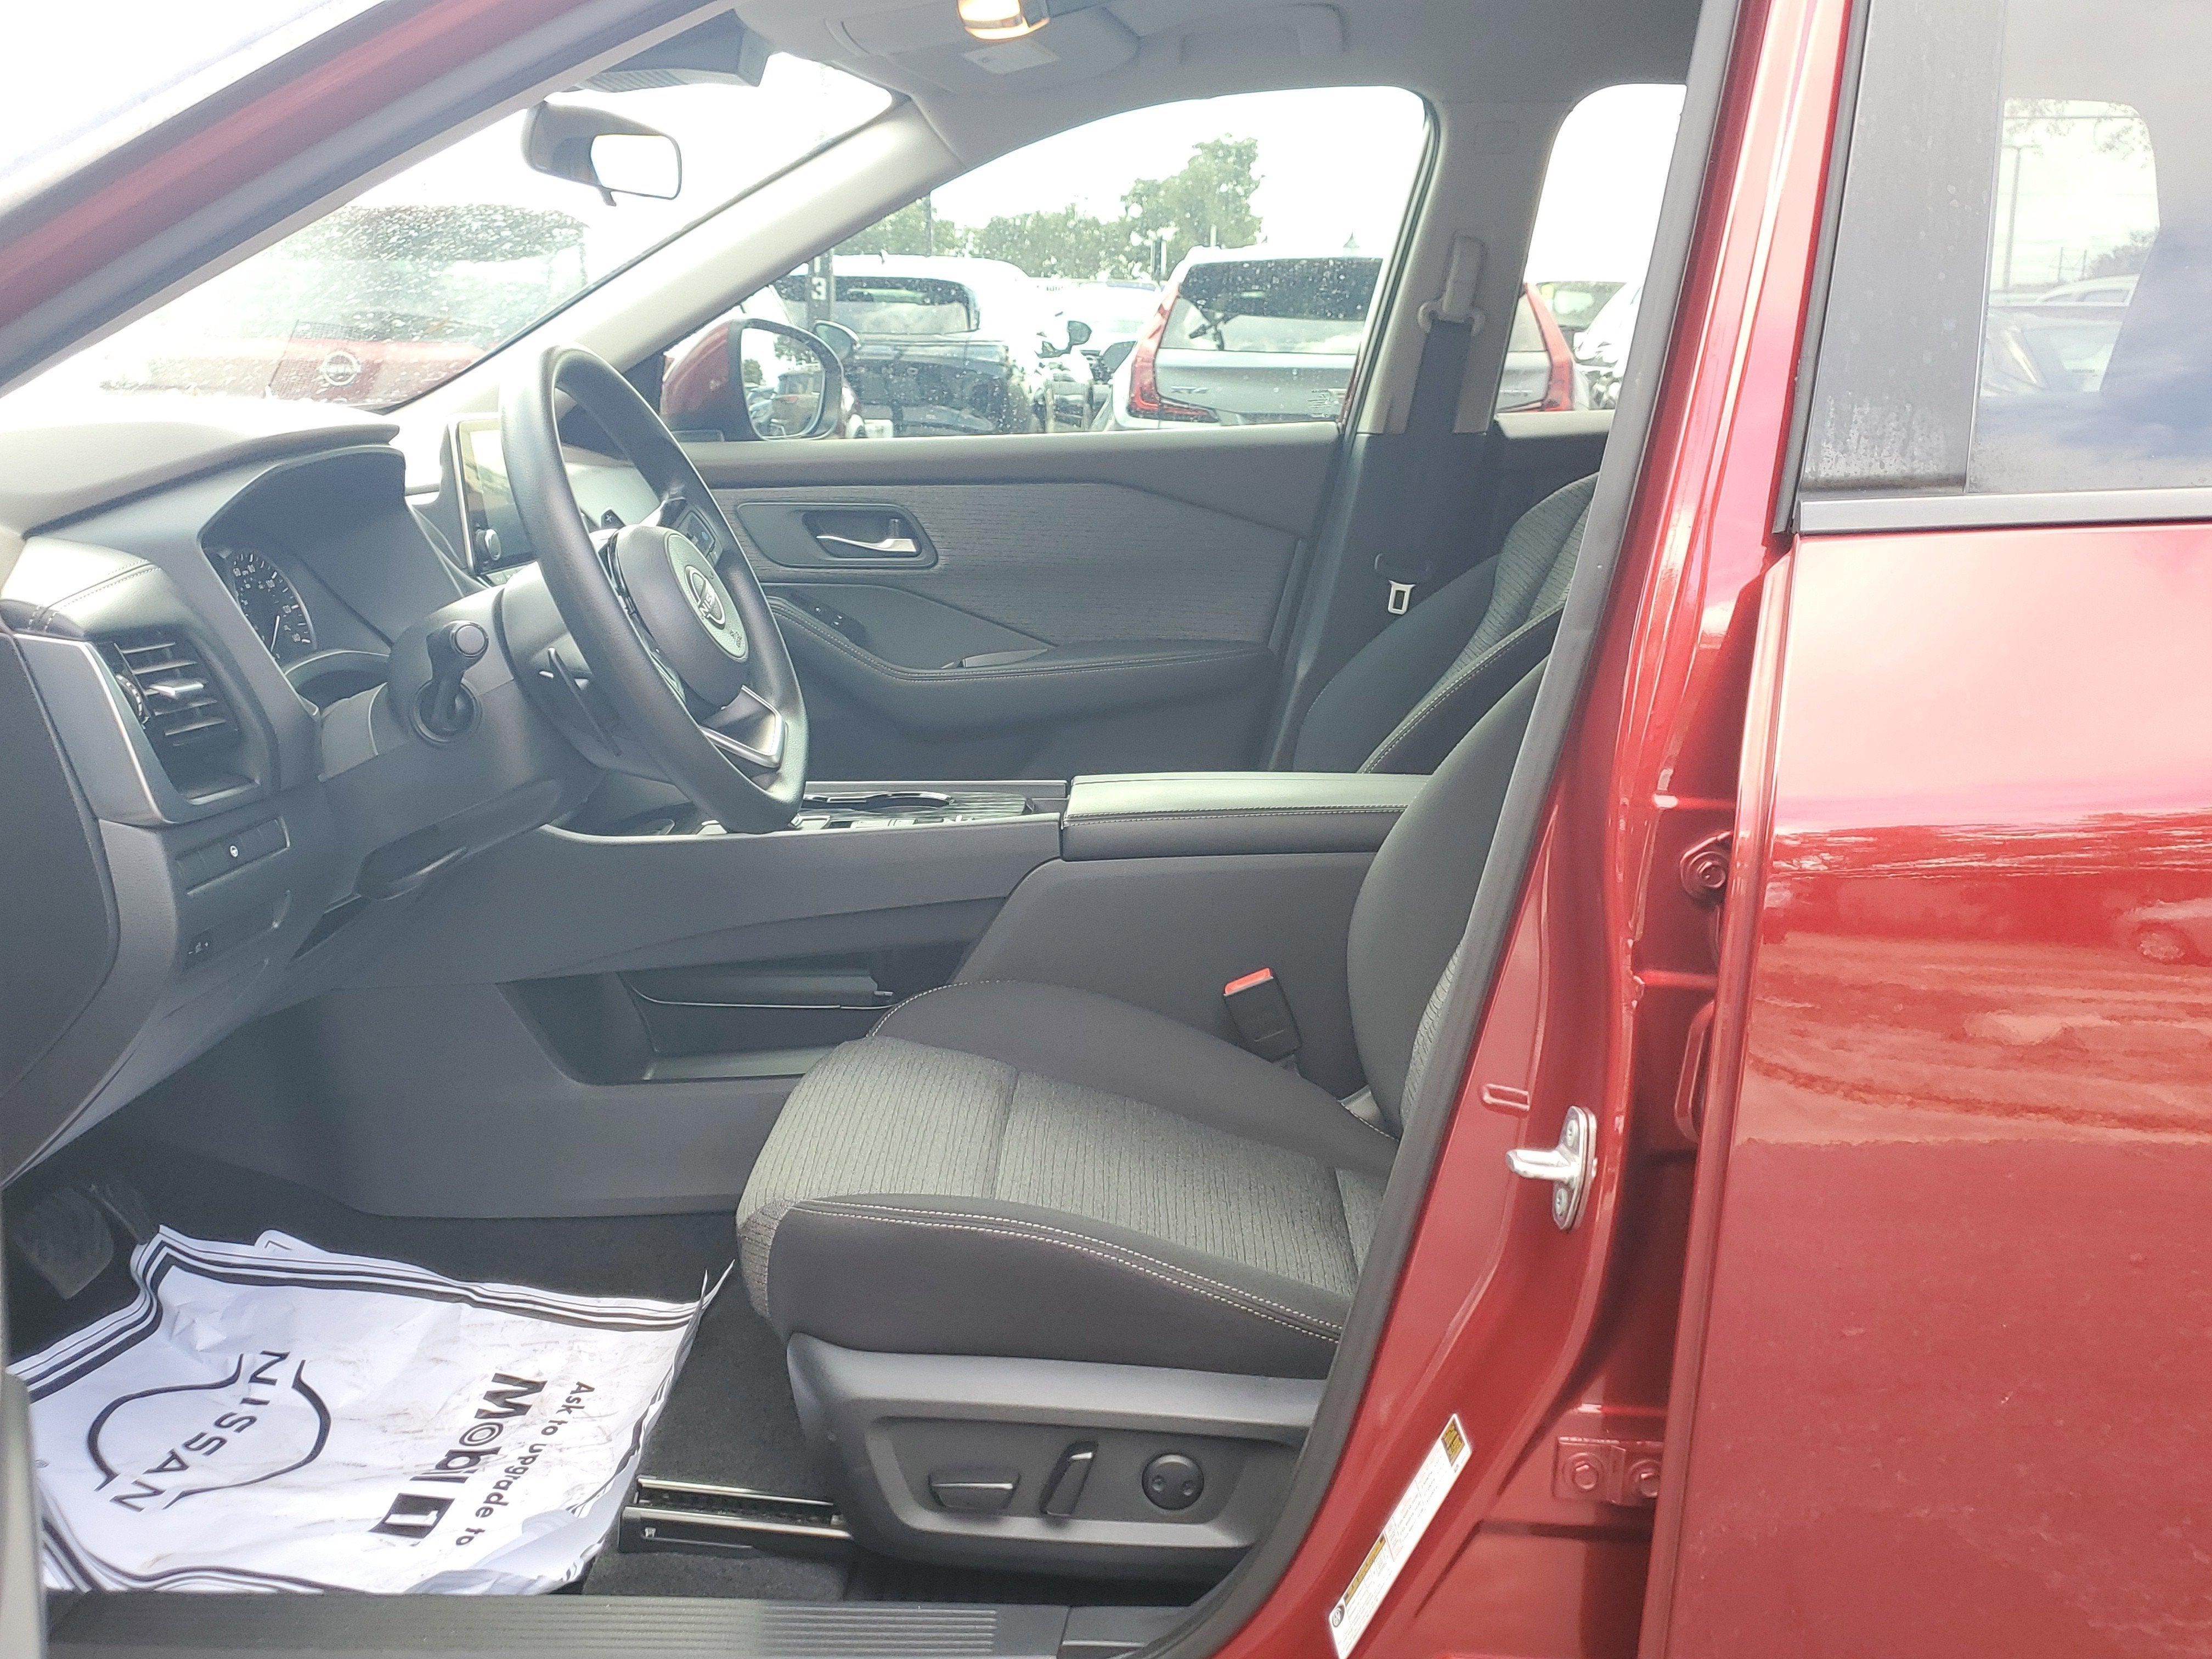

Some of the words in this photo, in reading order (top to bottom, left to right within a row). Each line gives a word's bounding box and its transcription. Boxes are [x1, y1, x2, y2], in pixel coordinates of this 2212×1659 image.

[811, 277, 826, 300] 3
[556, 1381, 595, 1415] Ask
[110, 1350, 290, 1512] NISSAN
[409, 1373, 548, 1483] Mobil
[541, 1420, 568, 1436] to
[476, 1443, 546, 1517] upgrade
[456, 1528, 485, 1545] to
